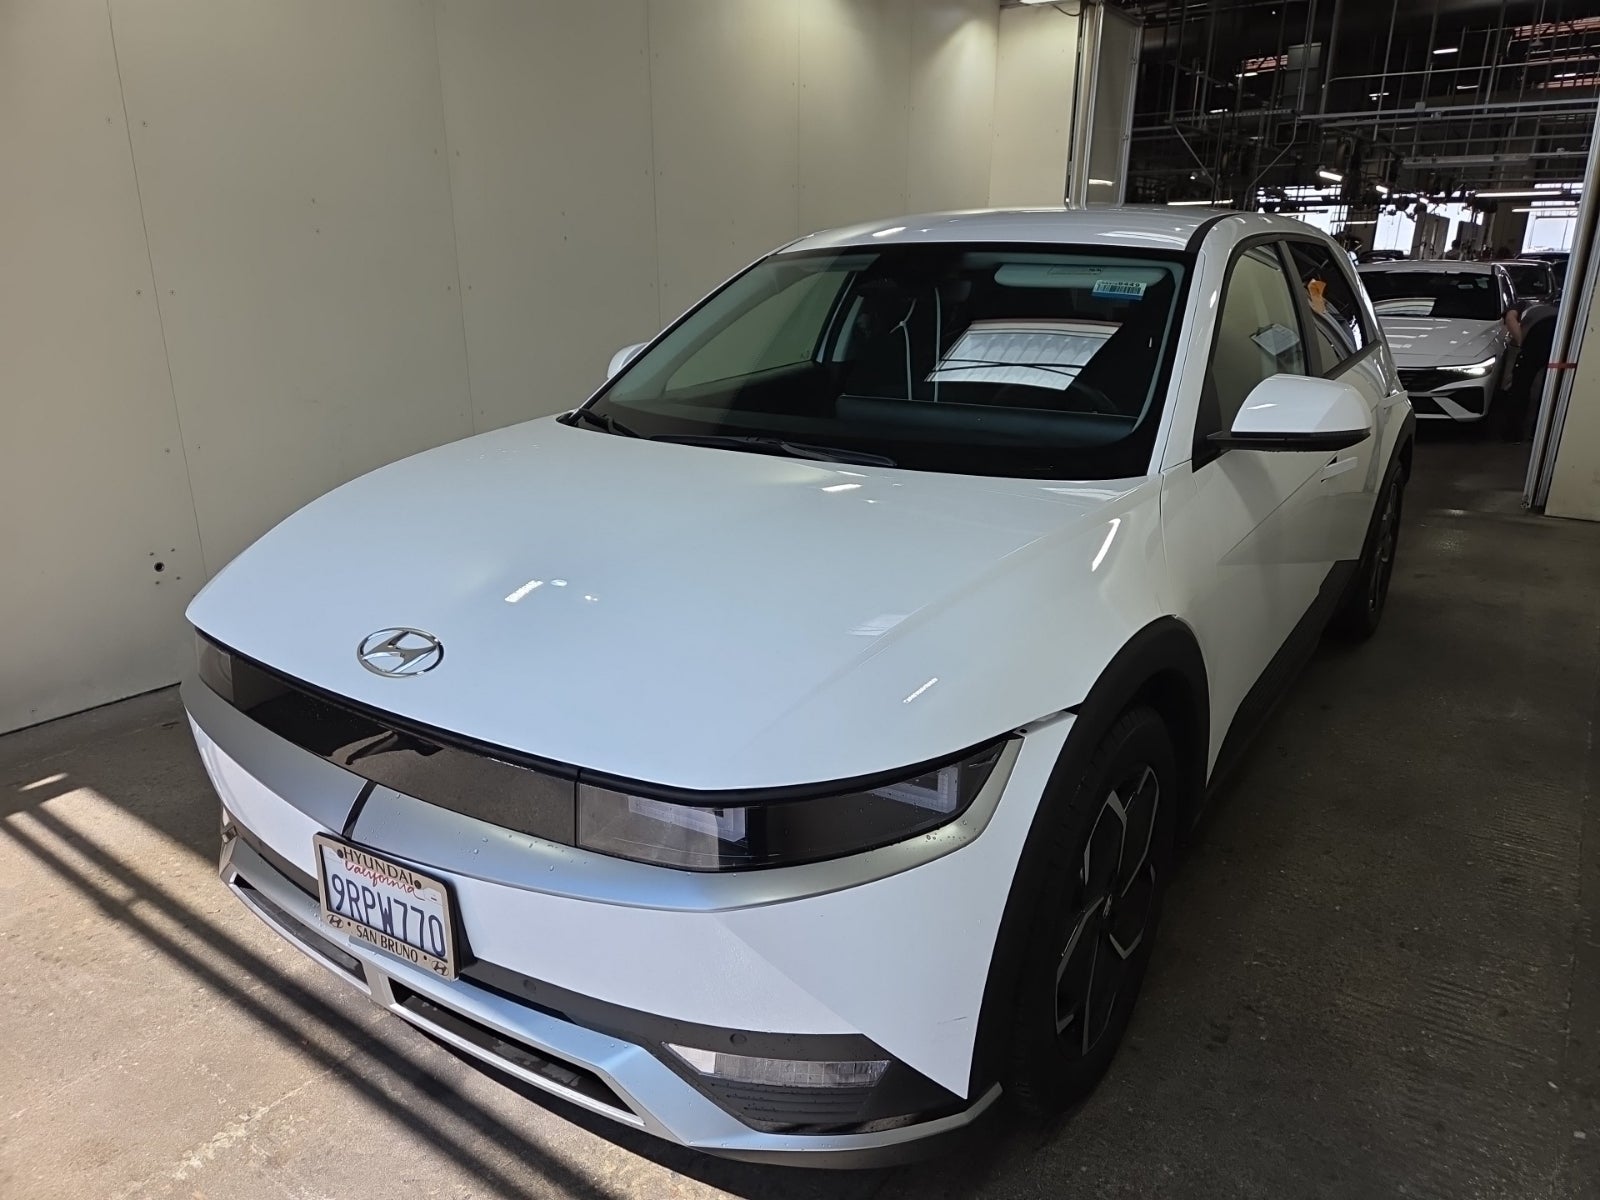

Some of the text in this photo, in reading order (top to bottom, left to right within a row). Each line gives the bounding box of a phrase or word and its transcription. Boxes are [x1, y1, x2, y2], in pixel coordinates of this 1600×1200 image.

[343, 846, 413, 885] HYUNDAI
[331, 873, 446, 958] 9RPW770
[356, 925, 418, 963] SAN BRUNO
